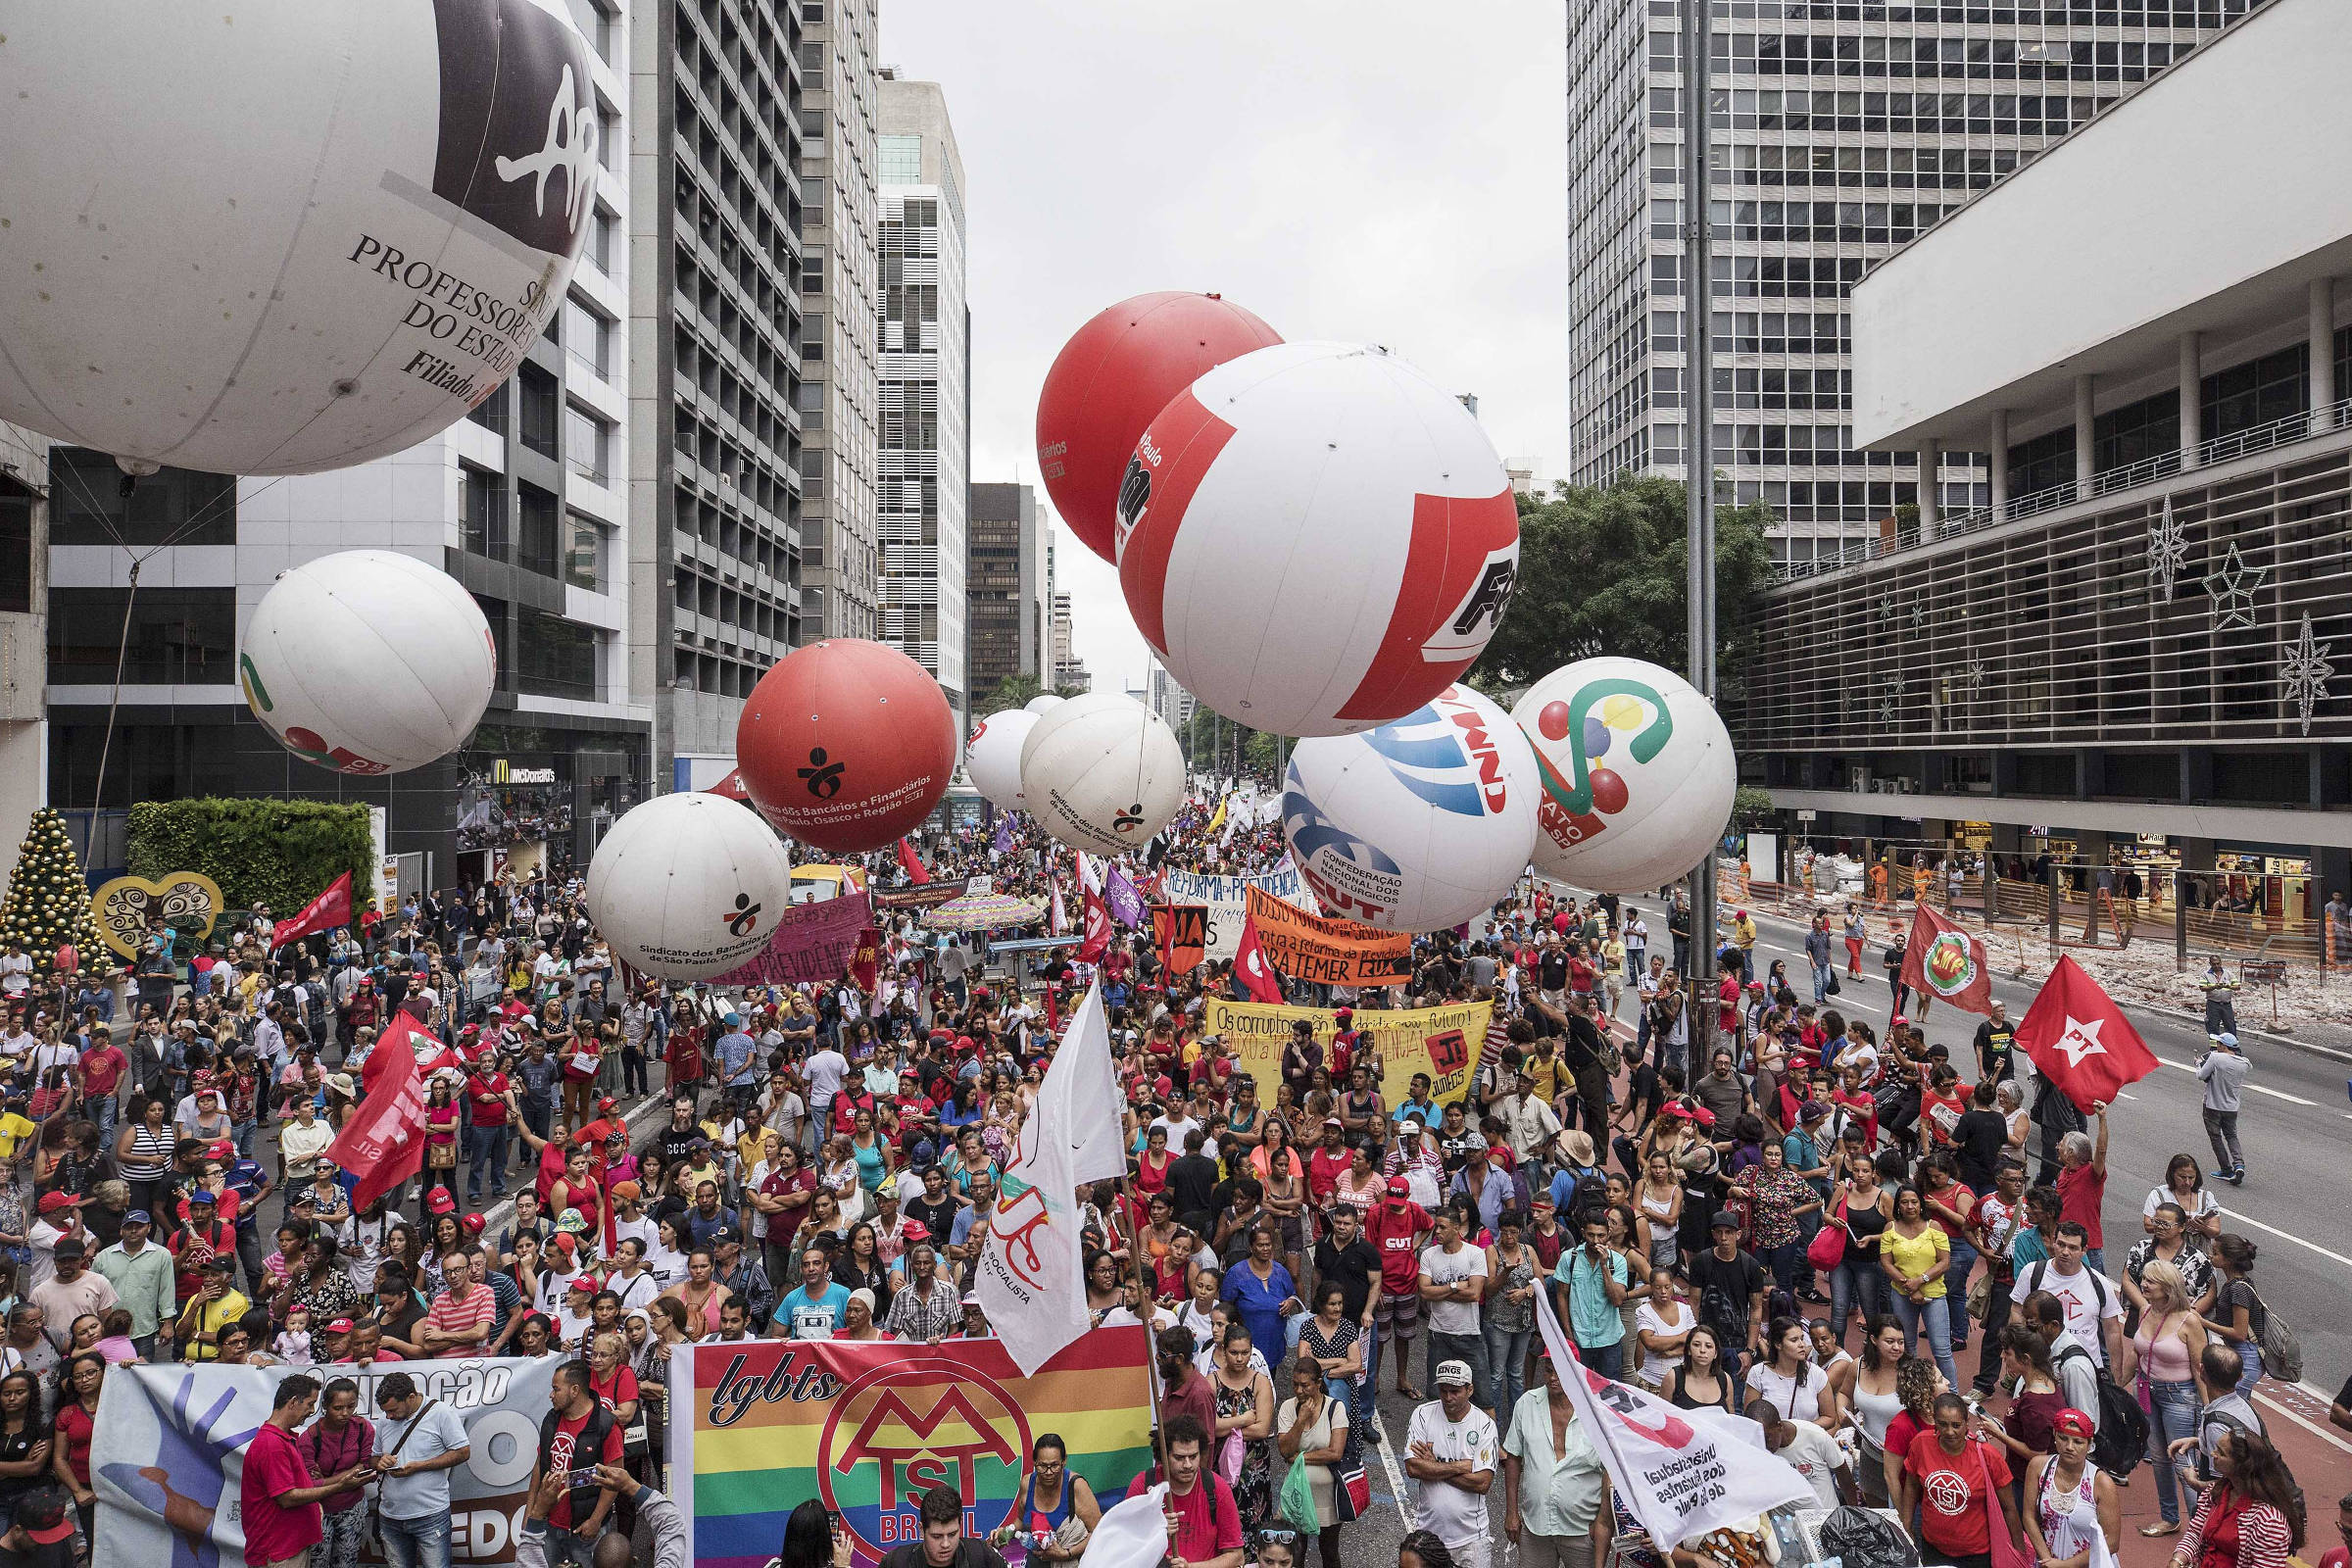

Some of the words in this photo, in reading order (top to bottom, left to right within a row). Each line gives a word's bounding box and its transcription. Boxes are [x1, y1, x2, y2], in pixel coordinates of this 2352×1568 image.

[347, 232, 538, 354] PROFESSORES
[402, 298, 458, 339] DO
[454, 324, 519, 382] ESTADO
[400, 349, 474, 398] Filiado
[511, 768, 556, 784] McDonald's
[782, 804, 801, 817] dos
[802, 801, 858, 817] Bancários
[859, 799, 867, 808] e
[870, 773, 931, 807] Financiários
[813, 812, 852, 826] Osasco
[854, 810, 861, 819] e
[863, 799, 902, 818] Região
[1049, 788, 1080, 819] Sindicato
[1079, 817, 1095, 831] dos
[1050, 799, 1058, 809] de
[1057, 807, 1070, 821] São
[1168, 866, 1223, 903] REFORMA
[1320, 867, 1399, 905] METALÚRGICOS
[1322, 858, 1373, 891] NACIONAL
[1376, 884, 1399, 897] DOS
[1323, 850, 1402, 888] CONFEDERAÇÃO
[1250, 887, 1290, 923] NOSSO
[639, 945, 690, 957] Sindicato
[691, 949, 713, 957] dos
[715, 936, 760, 956] Bancários
[649, 954, 662, 962] de
[663, 956, 683, 964] São
[1289, 937, 1297, 951] a
[1299, 936, 1340, 958] reforma
[1344, 947, 1357, 959] da
[1295, 953, 1349, 981] TEMER
[1217, 1006, 1234, 1031] Os
[1429, 1010, 1471, 1036] futuro!
[2065, 1029, 2093, 1053] PT
[1385, 1237, 1412, 1249] CUT
[988, 1251, 1031, 1305] SOCIALISTA
[1438, 1365, 1461, 1375] KINGS
[708, 1351, 844, 1428] lgbts
